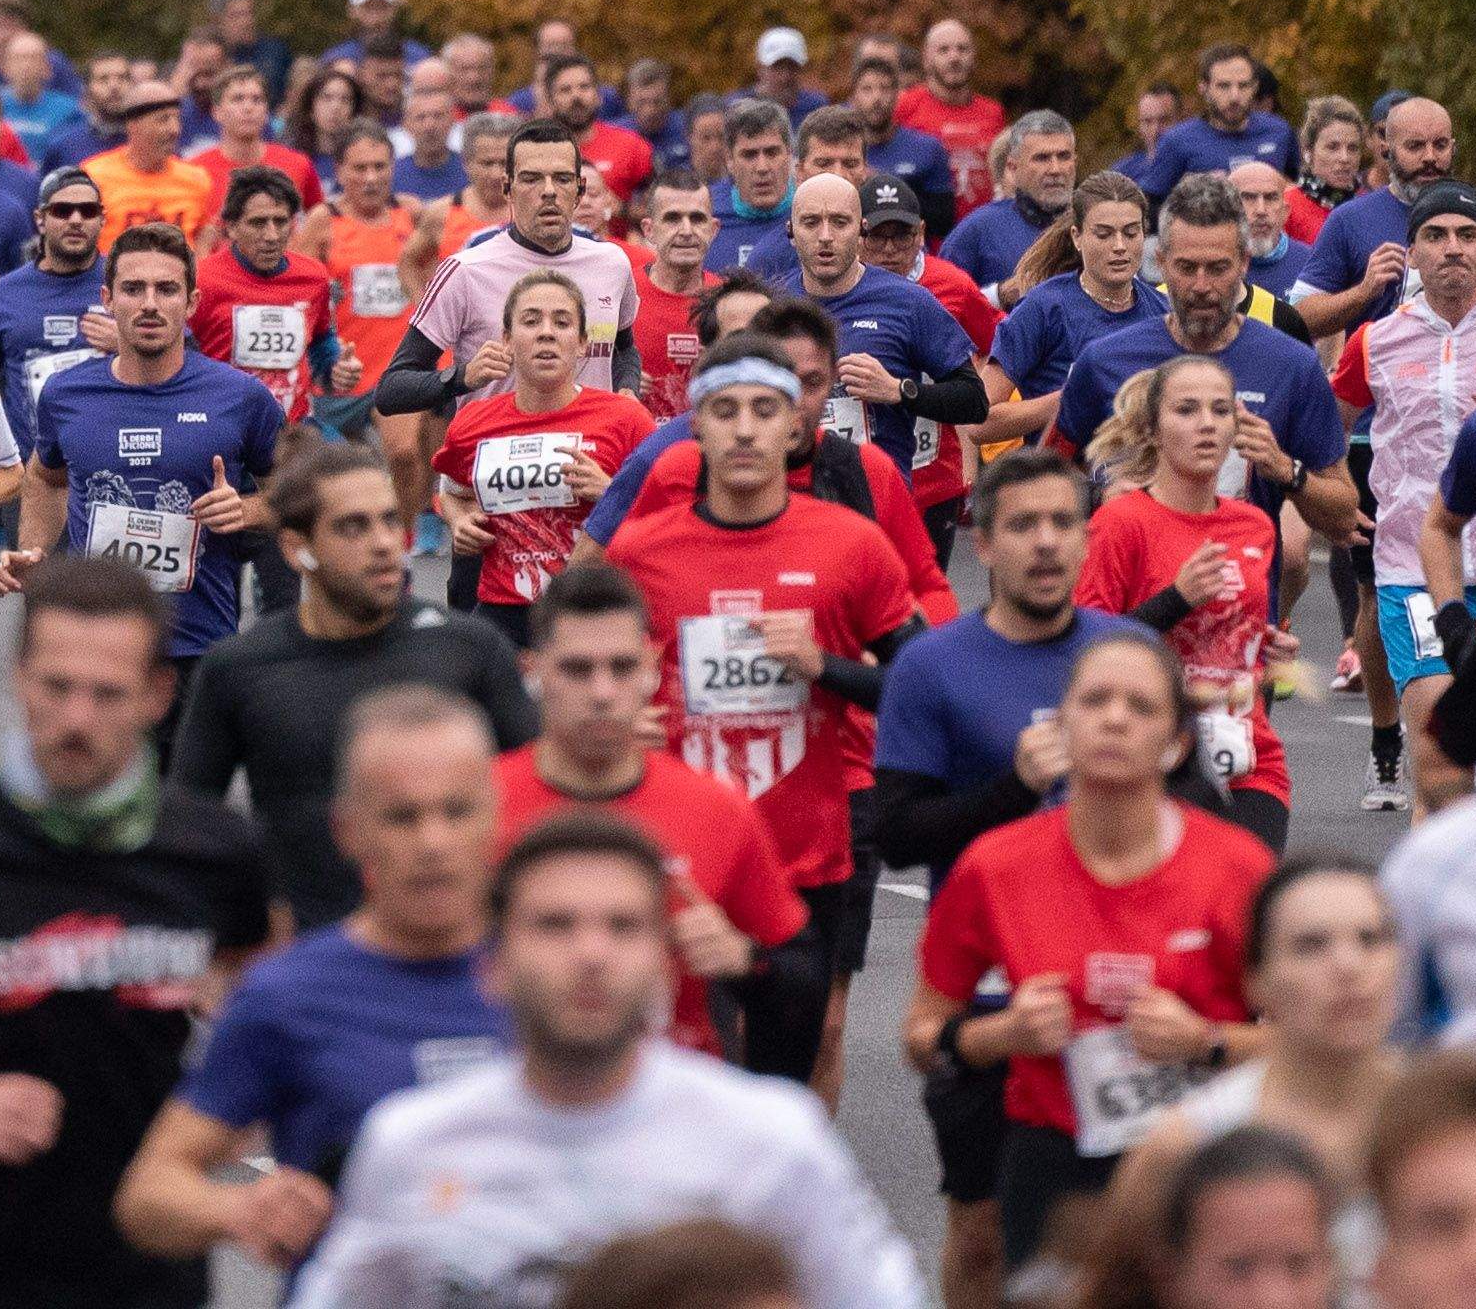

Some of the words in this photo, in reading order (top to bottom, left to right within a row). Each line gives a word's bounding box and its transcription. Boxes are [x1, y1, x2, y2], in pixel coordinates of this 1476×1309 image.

[248, 331, 296, 353] 2332
[177, 412, 208, 423] HOKA
[920, 432, 933, 453] 8
[487, 462, 561, 493] 4026
[102, 538, 181, 573] 4025
[704, 654, 794, 690] 2862
[1214, 747, 1235, 777] 9
